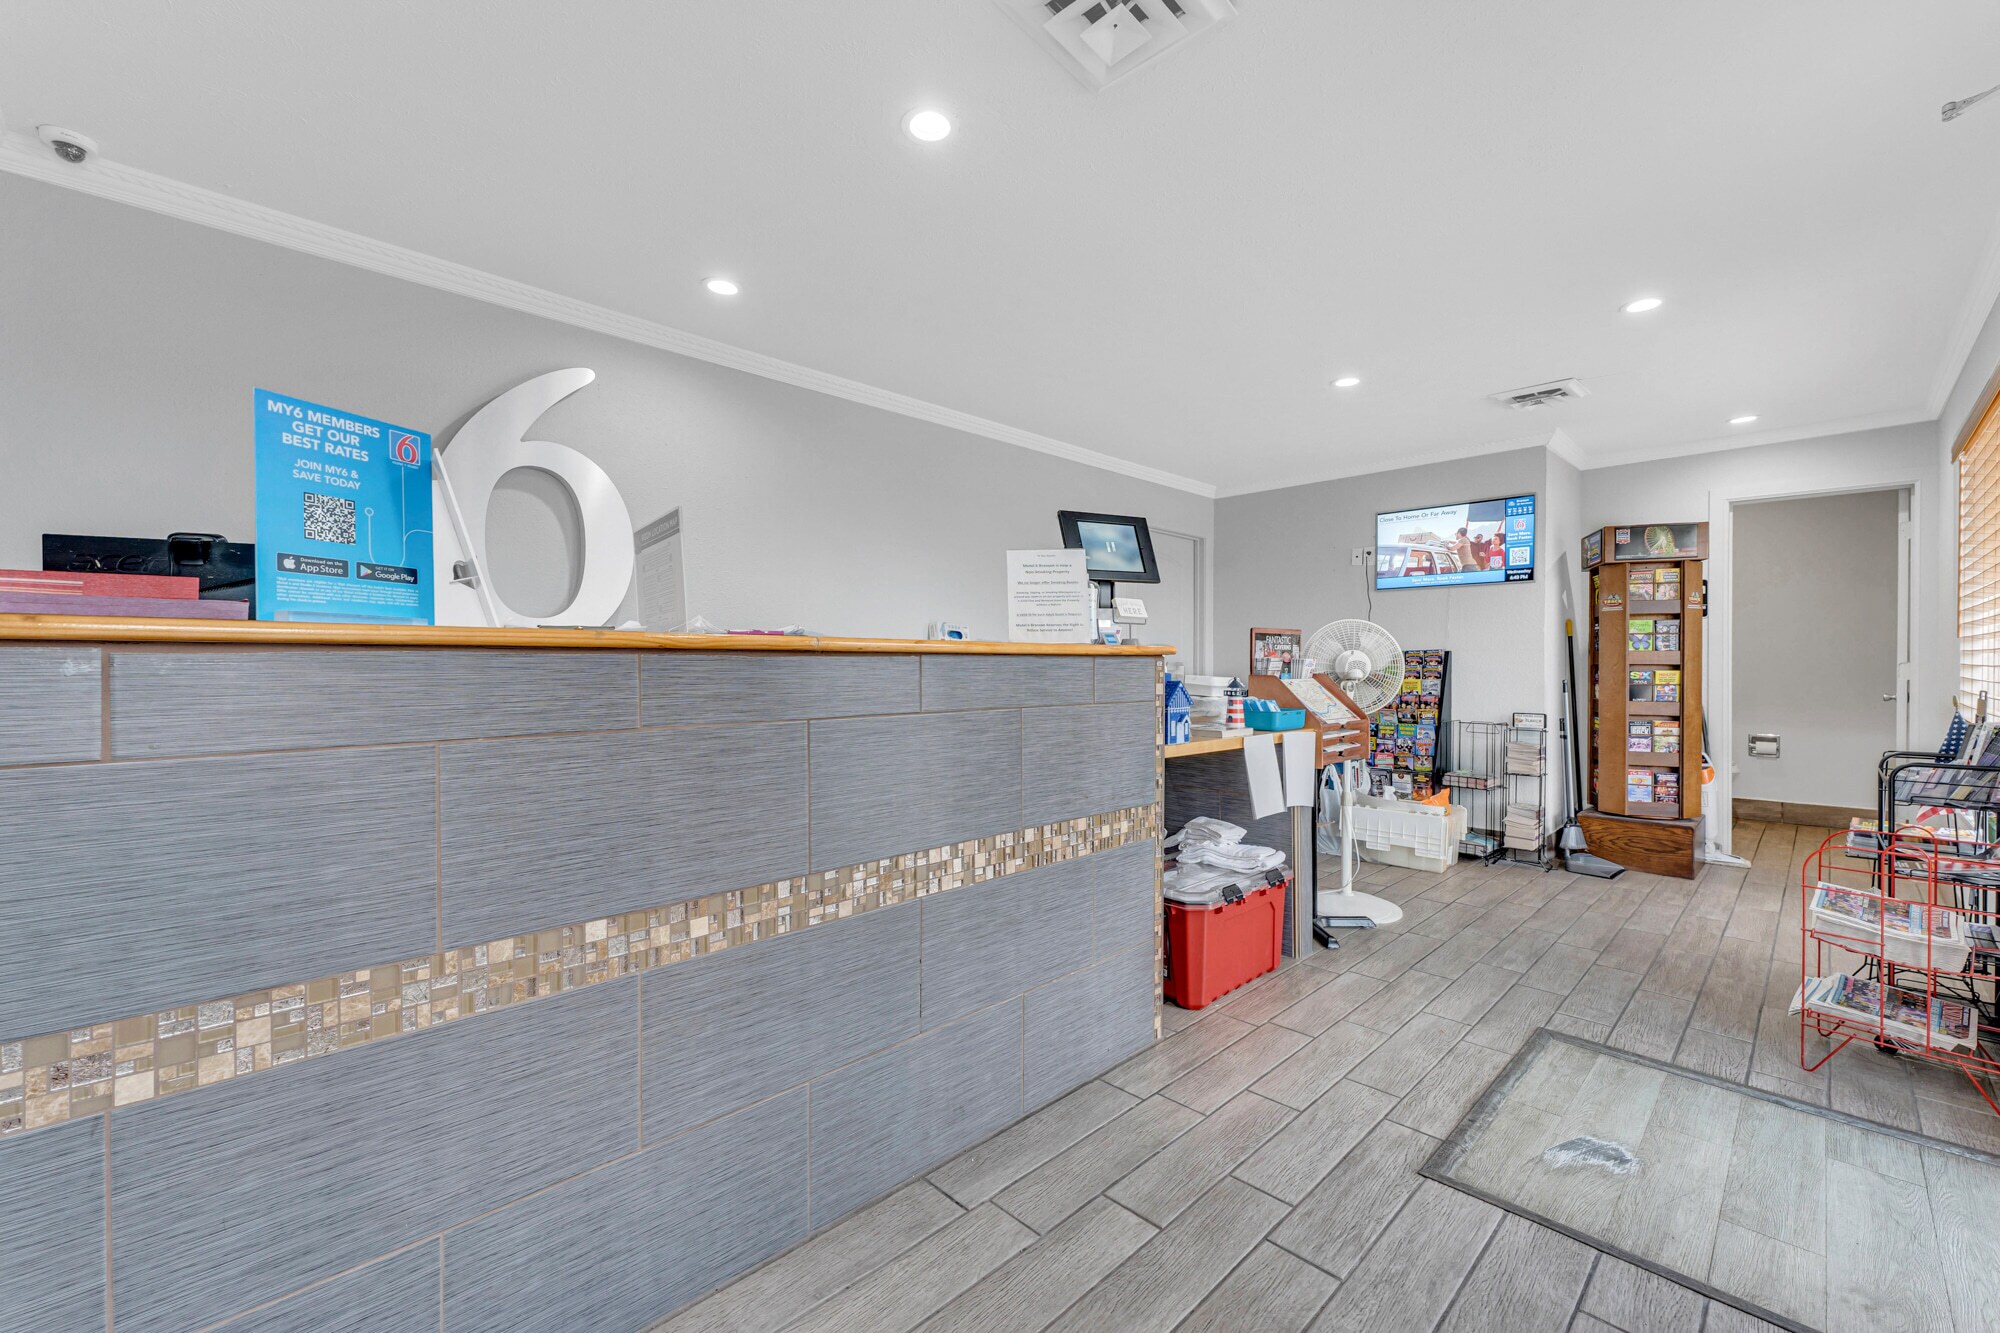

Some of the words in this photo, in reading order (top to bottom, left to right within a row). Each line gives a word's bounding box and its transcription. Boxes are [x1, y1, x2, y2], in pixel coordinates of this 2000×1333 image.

[267, 399, 303, 419] MY6
[307, 410, 380, 439] MEMBERS
[292, 421, 323, 437] GET
[327, 429, 360, 447] OUR
[282, 432, 320, 450] BEST
[324, 442, 369, 462] RATES
[396, 434, 418, 464] 6
[294, 458, 322, 472] JOIN
[325, 464, 348, 477] MY6
[350, 470, 359, 479] &
[292, 469, 322, 483] SAVE
[325, 475, 361, 490] TODAY
[431, 367, 635, 628] 6
[68, 553, 169, 573] acer
[300, 563, 320, 573] App
[320, 566, 344, 575] Store
[375, 571, 400, 581] Google
[401, 574, 414, 582] Play
[1123, 607, 1143, 615] HERE
[1266, 635, 1291, 644] FANTASTIC
[1630, 671, 1651, 680] SIX
